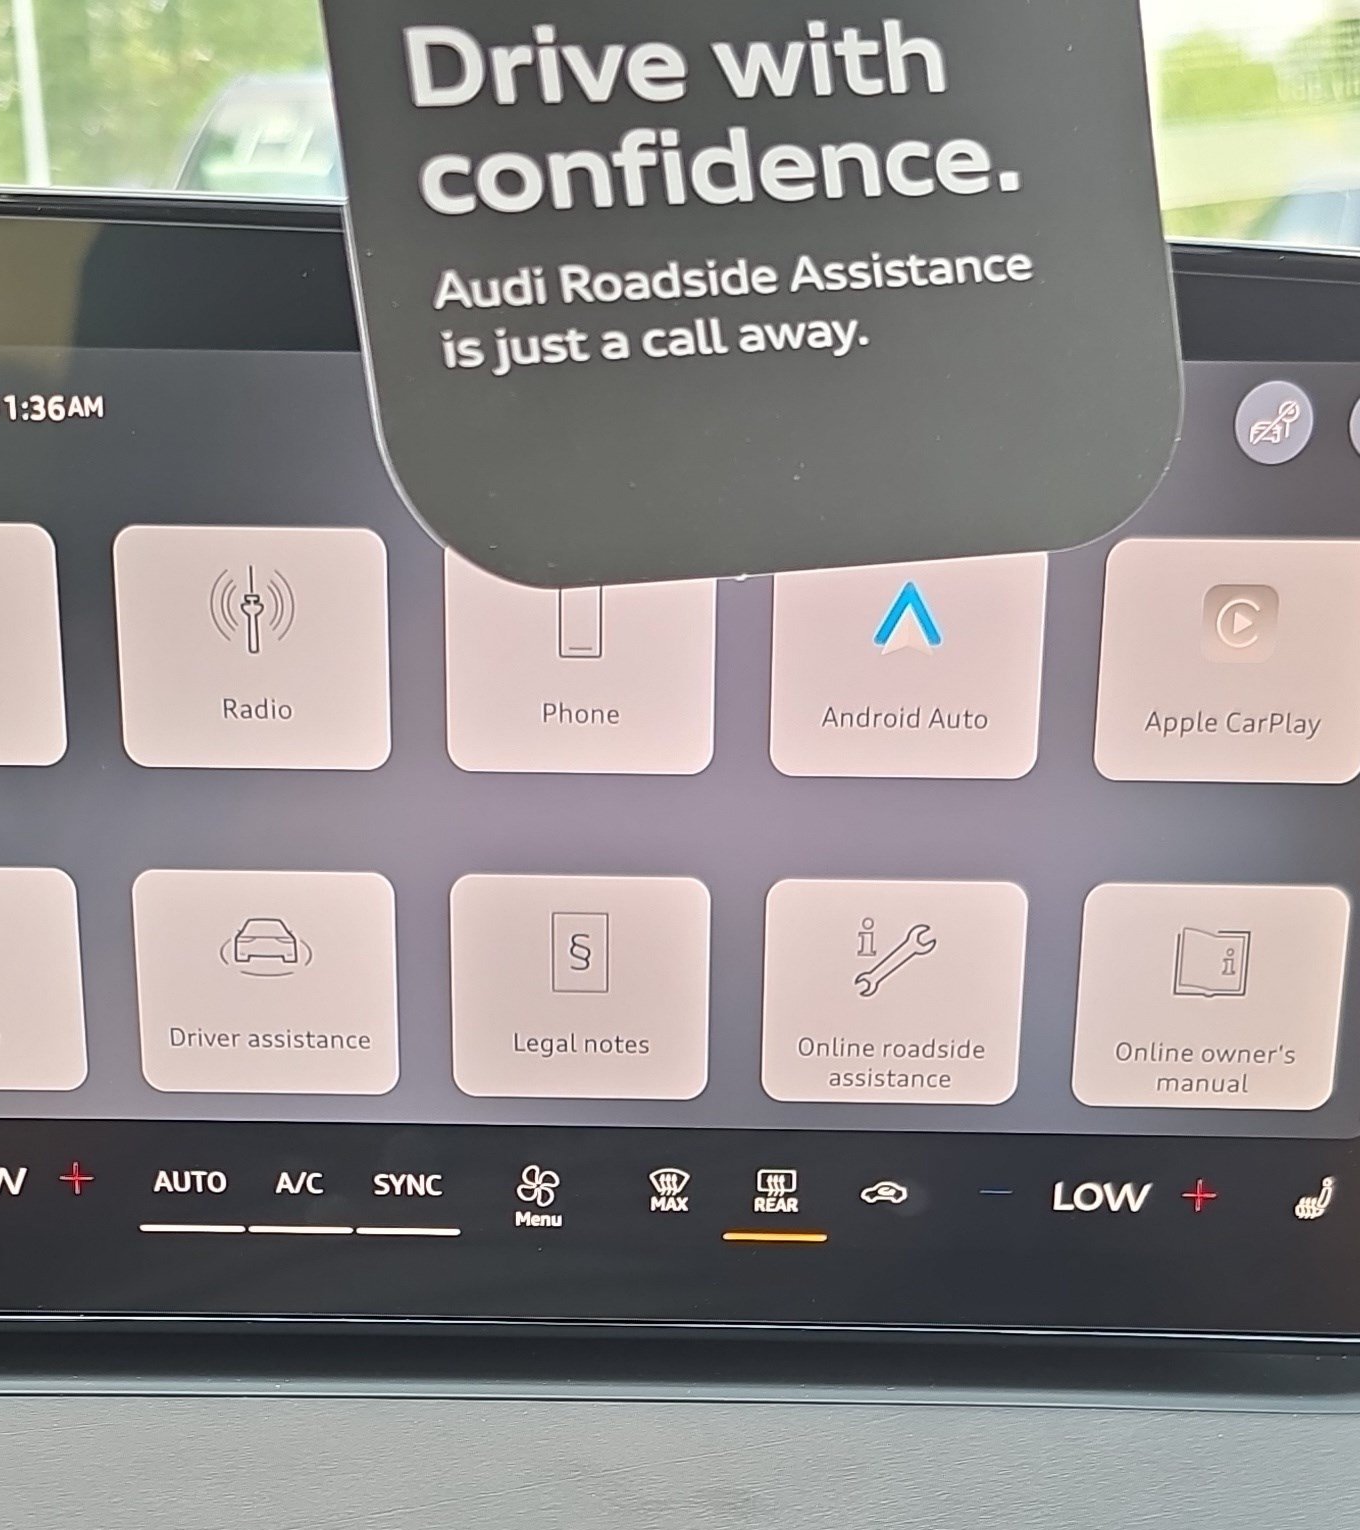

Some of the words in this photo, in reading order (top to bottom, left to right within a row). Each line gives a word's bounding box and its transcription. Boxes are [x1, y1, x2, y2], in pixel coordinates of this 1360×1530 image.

[403, 23, 687, 107] Drive
[711, 18, 946, 98] with
[421, 126, 1020, 215] confidence.
[434, 266, 547, 310] Audi
[559, 258, 778, 304] Roadside
[790, 252, 1033, 292] Assistance
[441, 329, 485, 368] is
[492, 327, 591, 376] just
[601, 330, 630, 360] a
[642, 317, 729, 358] call
[739, 319, 869, 357] away.
[223, 697, 292, 720] Radio
[543, 701, 620, 725] Phone
[821, 705, 921, 729] Android
[928, 707, 988, 730] Auto
[1144, 710, 1218, 738] Apple
[1226, 711, 1322, 740] CarPlay
[170, 1027, 241, 1048] Driver
[247, 1028, 371, 1050] assistance
[514, 1032, 577, 1058] Legal
[584, 1035, 650, 1054] notes
[798, 1036, 875, 1058] Online
[883, 1038, 985, 1059] roadside
[1115, 1041, 1194, 1063] Online
[1201, 1044, 1296, 1065] owner's
[829, 1067, 951, 1088] assistance
[1156, 1073, 1248, 1093] manual
[153, 1170, 227, 1193] AUTO
[275, 1171, 324, 1195] A/C
[373, 1173, 443, 1196] SYNC
[650, 1195, 689, 1212] MAX
[754, 1196, 799, 1213] REAR
[1053, 1181, 1153, 1213] LOW
[515, 1210, 563, 1227] Menu
